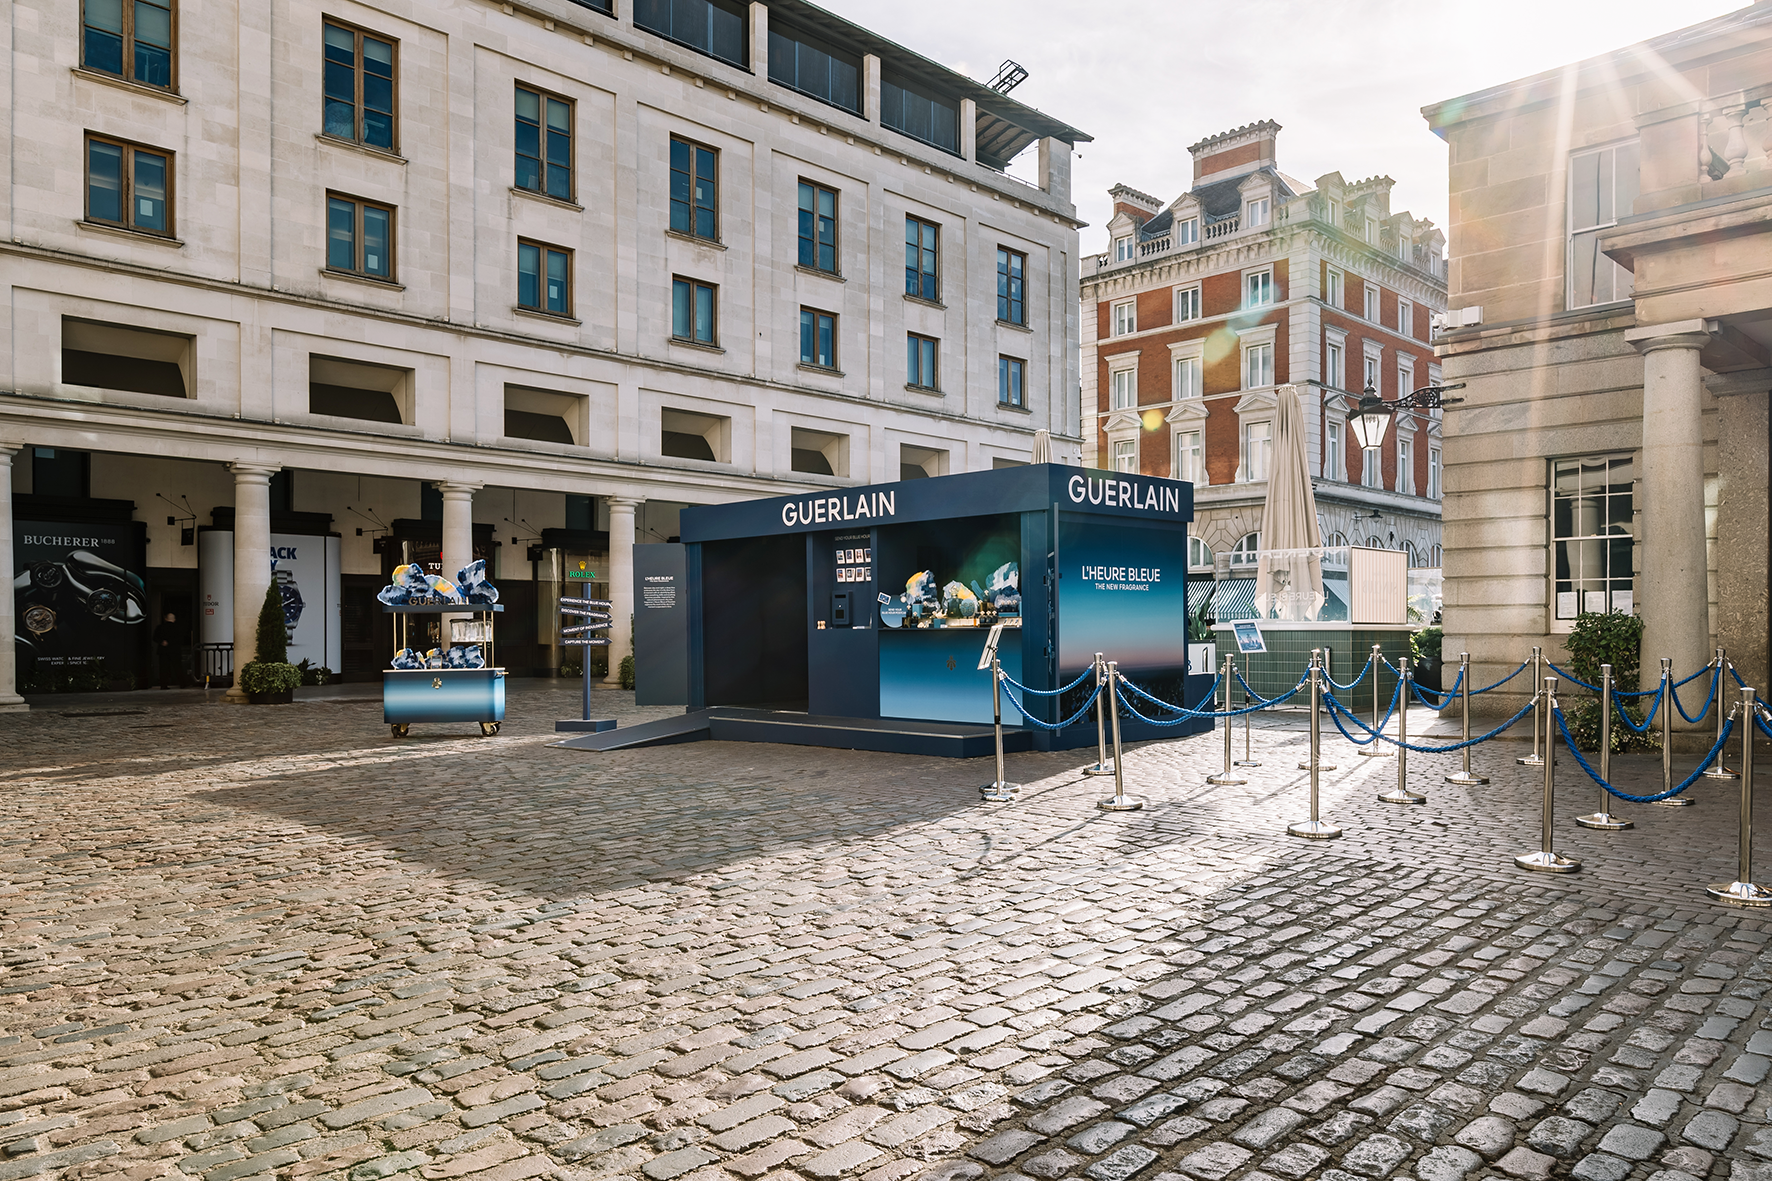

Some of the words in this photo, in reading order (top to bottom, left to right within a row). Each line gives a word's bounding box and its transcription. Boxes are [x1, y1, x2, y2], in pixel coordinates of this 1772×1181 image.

[1068, 475, 1179, 513] GUERLAIN
[782, 491, 896, 527] GUERLAIN
[23, 534, 99, 548] BUCHERER
[1082, 565, 1126, 581] L'HEURE
[1128, 567, 1161, 582] BLEUE
[1106, 583, 1118, 591] NEW
[1119, 583, 1149, 591] FRAGRANCE
[408, 596, 469, 606] GUERLAIN
